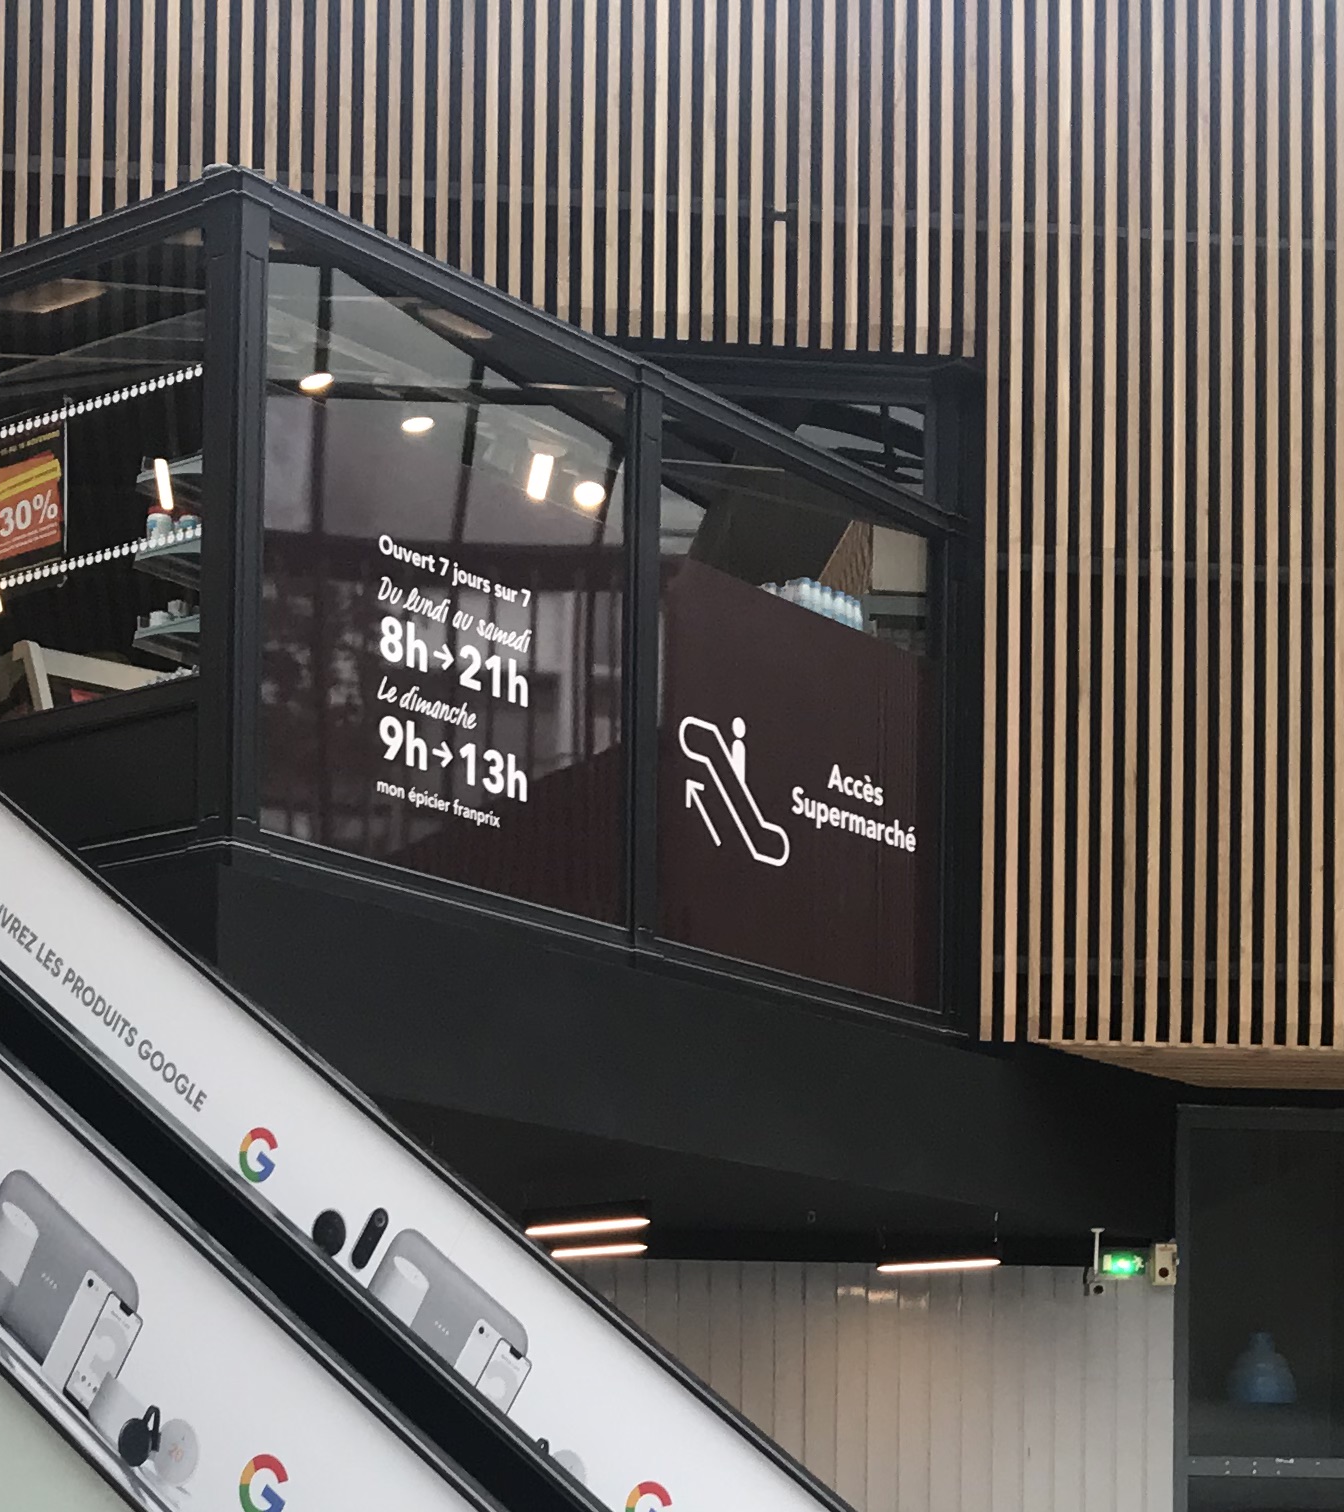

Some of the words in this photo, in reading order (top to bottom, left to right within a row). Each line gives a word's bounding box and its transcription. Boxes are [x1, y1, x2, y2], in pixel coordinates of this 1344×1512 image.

[379, 534, 436, 573] Ouvert
[439, 557, 450, 576] 7
[452, 562, 491, 593] jours
[494, 581, 518, 603] sur
[521, 589, 532, 608] 7
[378, 576, 403, 605] Du
[403, 587, 451, 624] lundi
[452, 610, 474, 631] au
[476, 618, 532, 653] samedi
[379, 616, 429, 673] 8h
[459, 644, 529, 708] 21h
[377, 676, 398, 703] Le
[399, 685, 477, 730] dimanche
[379, 715, 428, 771] 9h
[459, 743, 528, 803] 13h
[827, 763, 884, 806] Accès
[376, 780, 406, 800] mon
[407, 786, 451, 814] épicier
[453, 799, 501, 828] franprix
[791, 786, 916, 852] Supermarché
[34, 942, 65, 980] LES
[62, 966, 139, 1048] PRODUITS
[136, 1037, 208, 1114] GOOGLE
